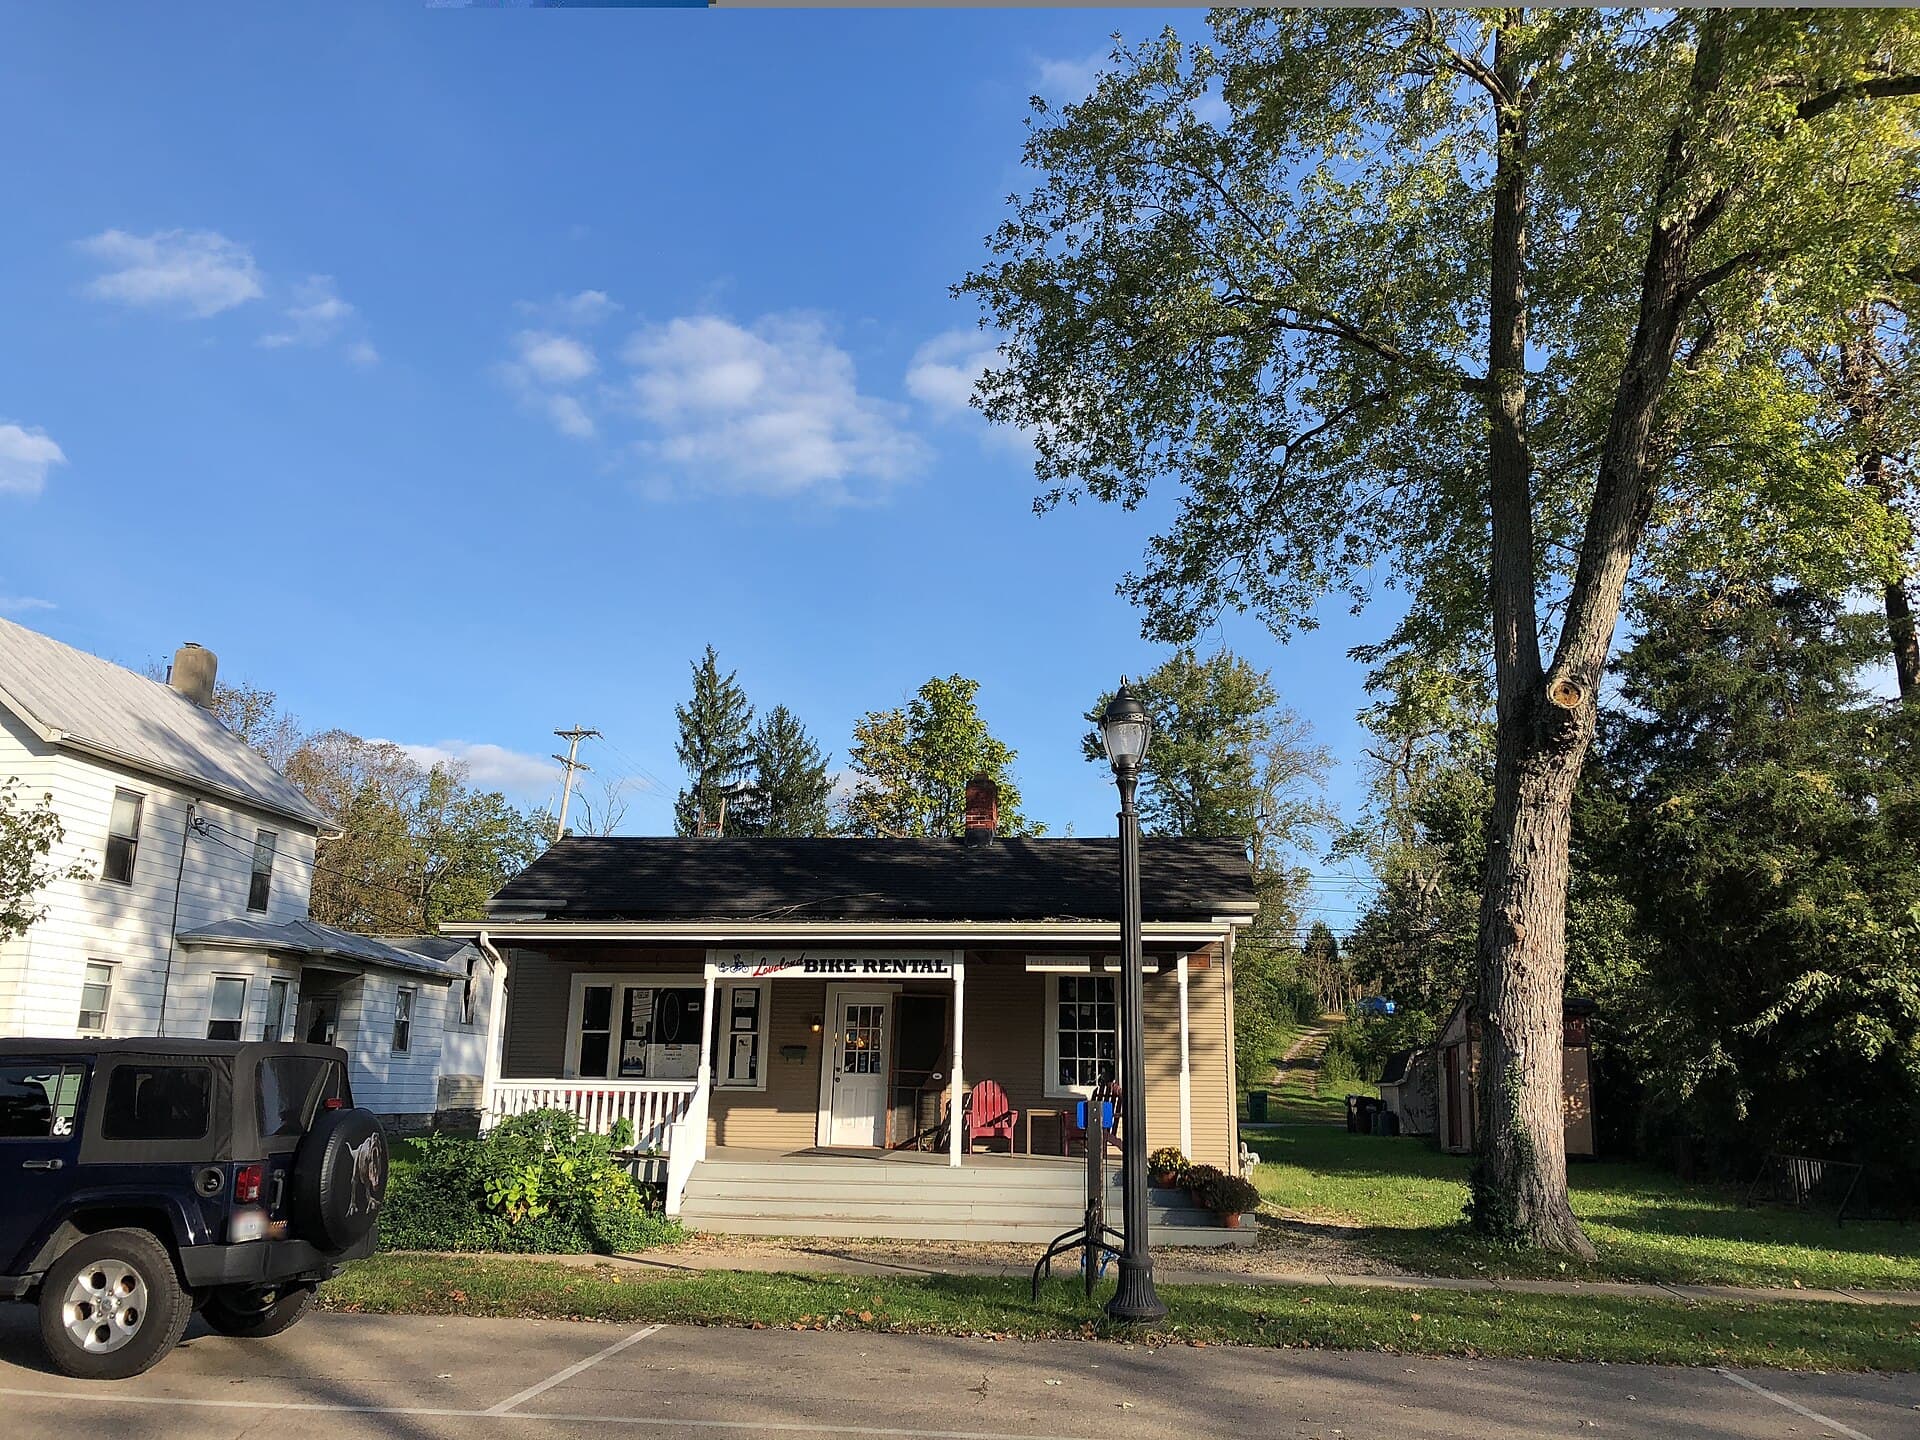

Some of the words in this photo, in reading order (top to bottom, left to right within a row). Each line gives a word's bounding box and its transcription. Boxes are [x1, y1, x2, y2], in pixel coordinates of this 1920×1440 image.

[753, 952, 805, 976] Loveland
[804, 958, 857, 973] BIKE
[863, 958, 947, 973] RENTAL
